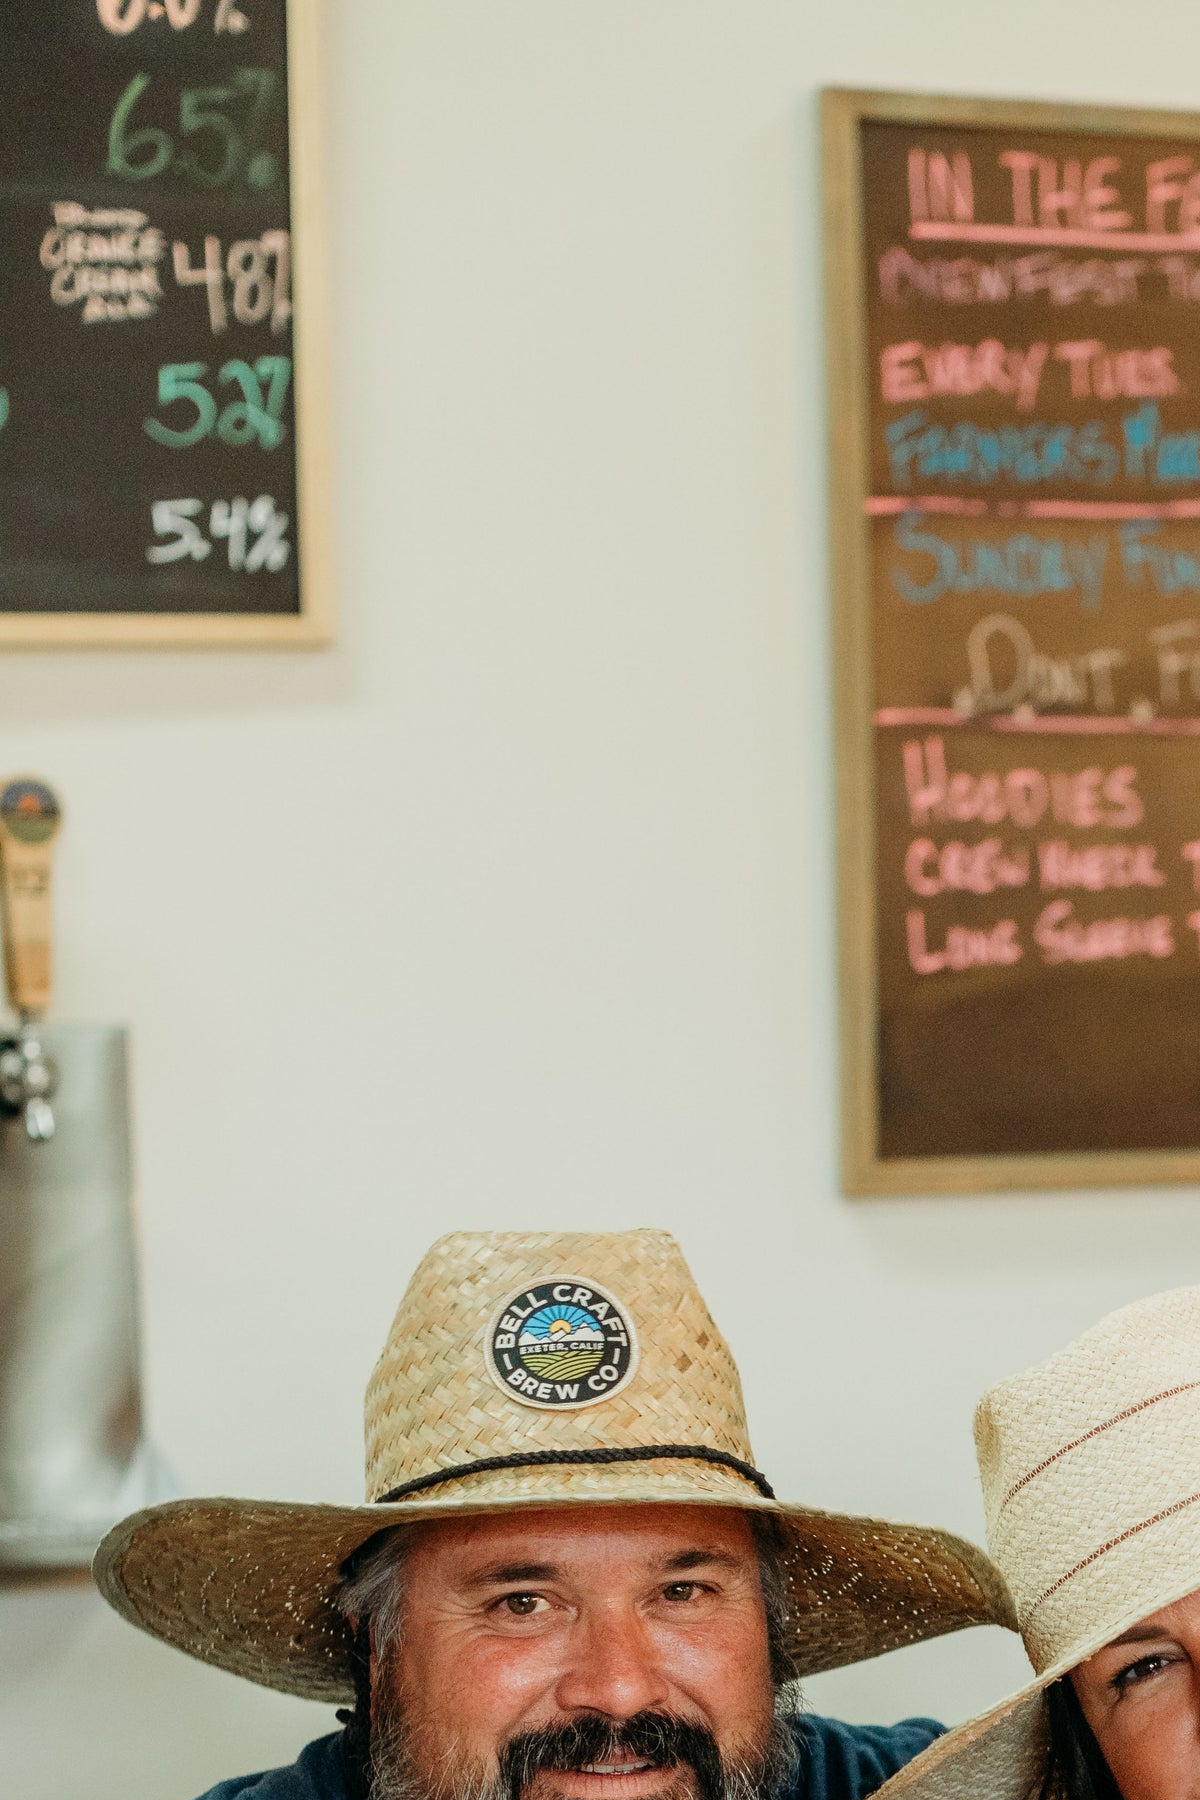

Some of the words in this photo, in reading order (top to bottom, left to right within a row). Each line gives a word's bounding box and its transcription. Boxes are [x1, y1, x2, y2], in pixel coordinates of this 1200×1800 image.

[908, 148, 975, 224] IN
[1000, 150, 1131, 232] THE
[902, 735, 1145, 829] HOODIES
[495, 1292, 548, 1349] BELL
[552, 1284, 627, 1348] CRAFT
[570, 1341, 605, 1351] CALIF
[506, 1367, 580, 1400] BREW
[587, 1364, 619, 1391] CO
